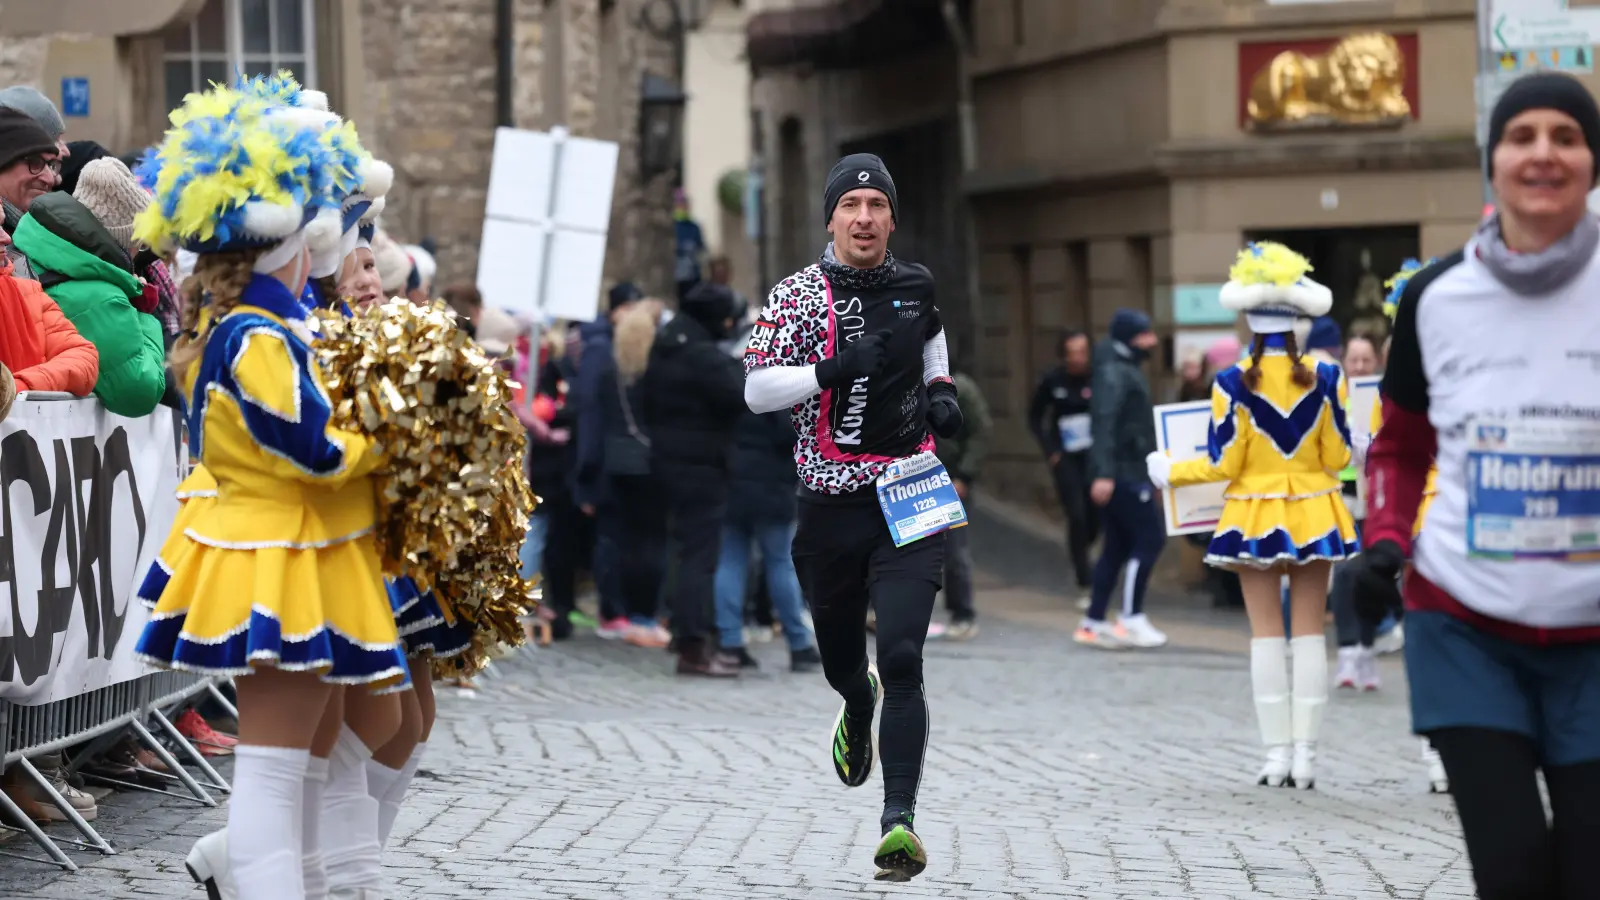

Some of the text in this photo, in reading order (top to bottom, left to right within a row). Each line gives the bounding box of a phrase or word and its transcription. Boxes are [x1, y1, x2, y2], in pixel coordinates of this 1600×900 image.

[751, 324, 775, 341] UN
[748, 338, 771, 352] CR
[887, 471, 951, 503] Thomas
[913, 497, 937, 512] 1225
